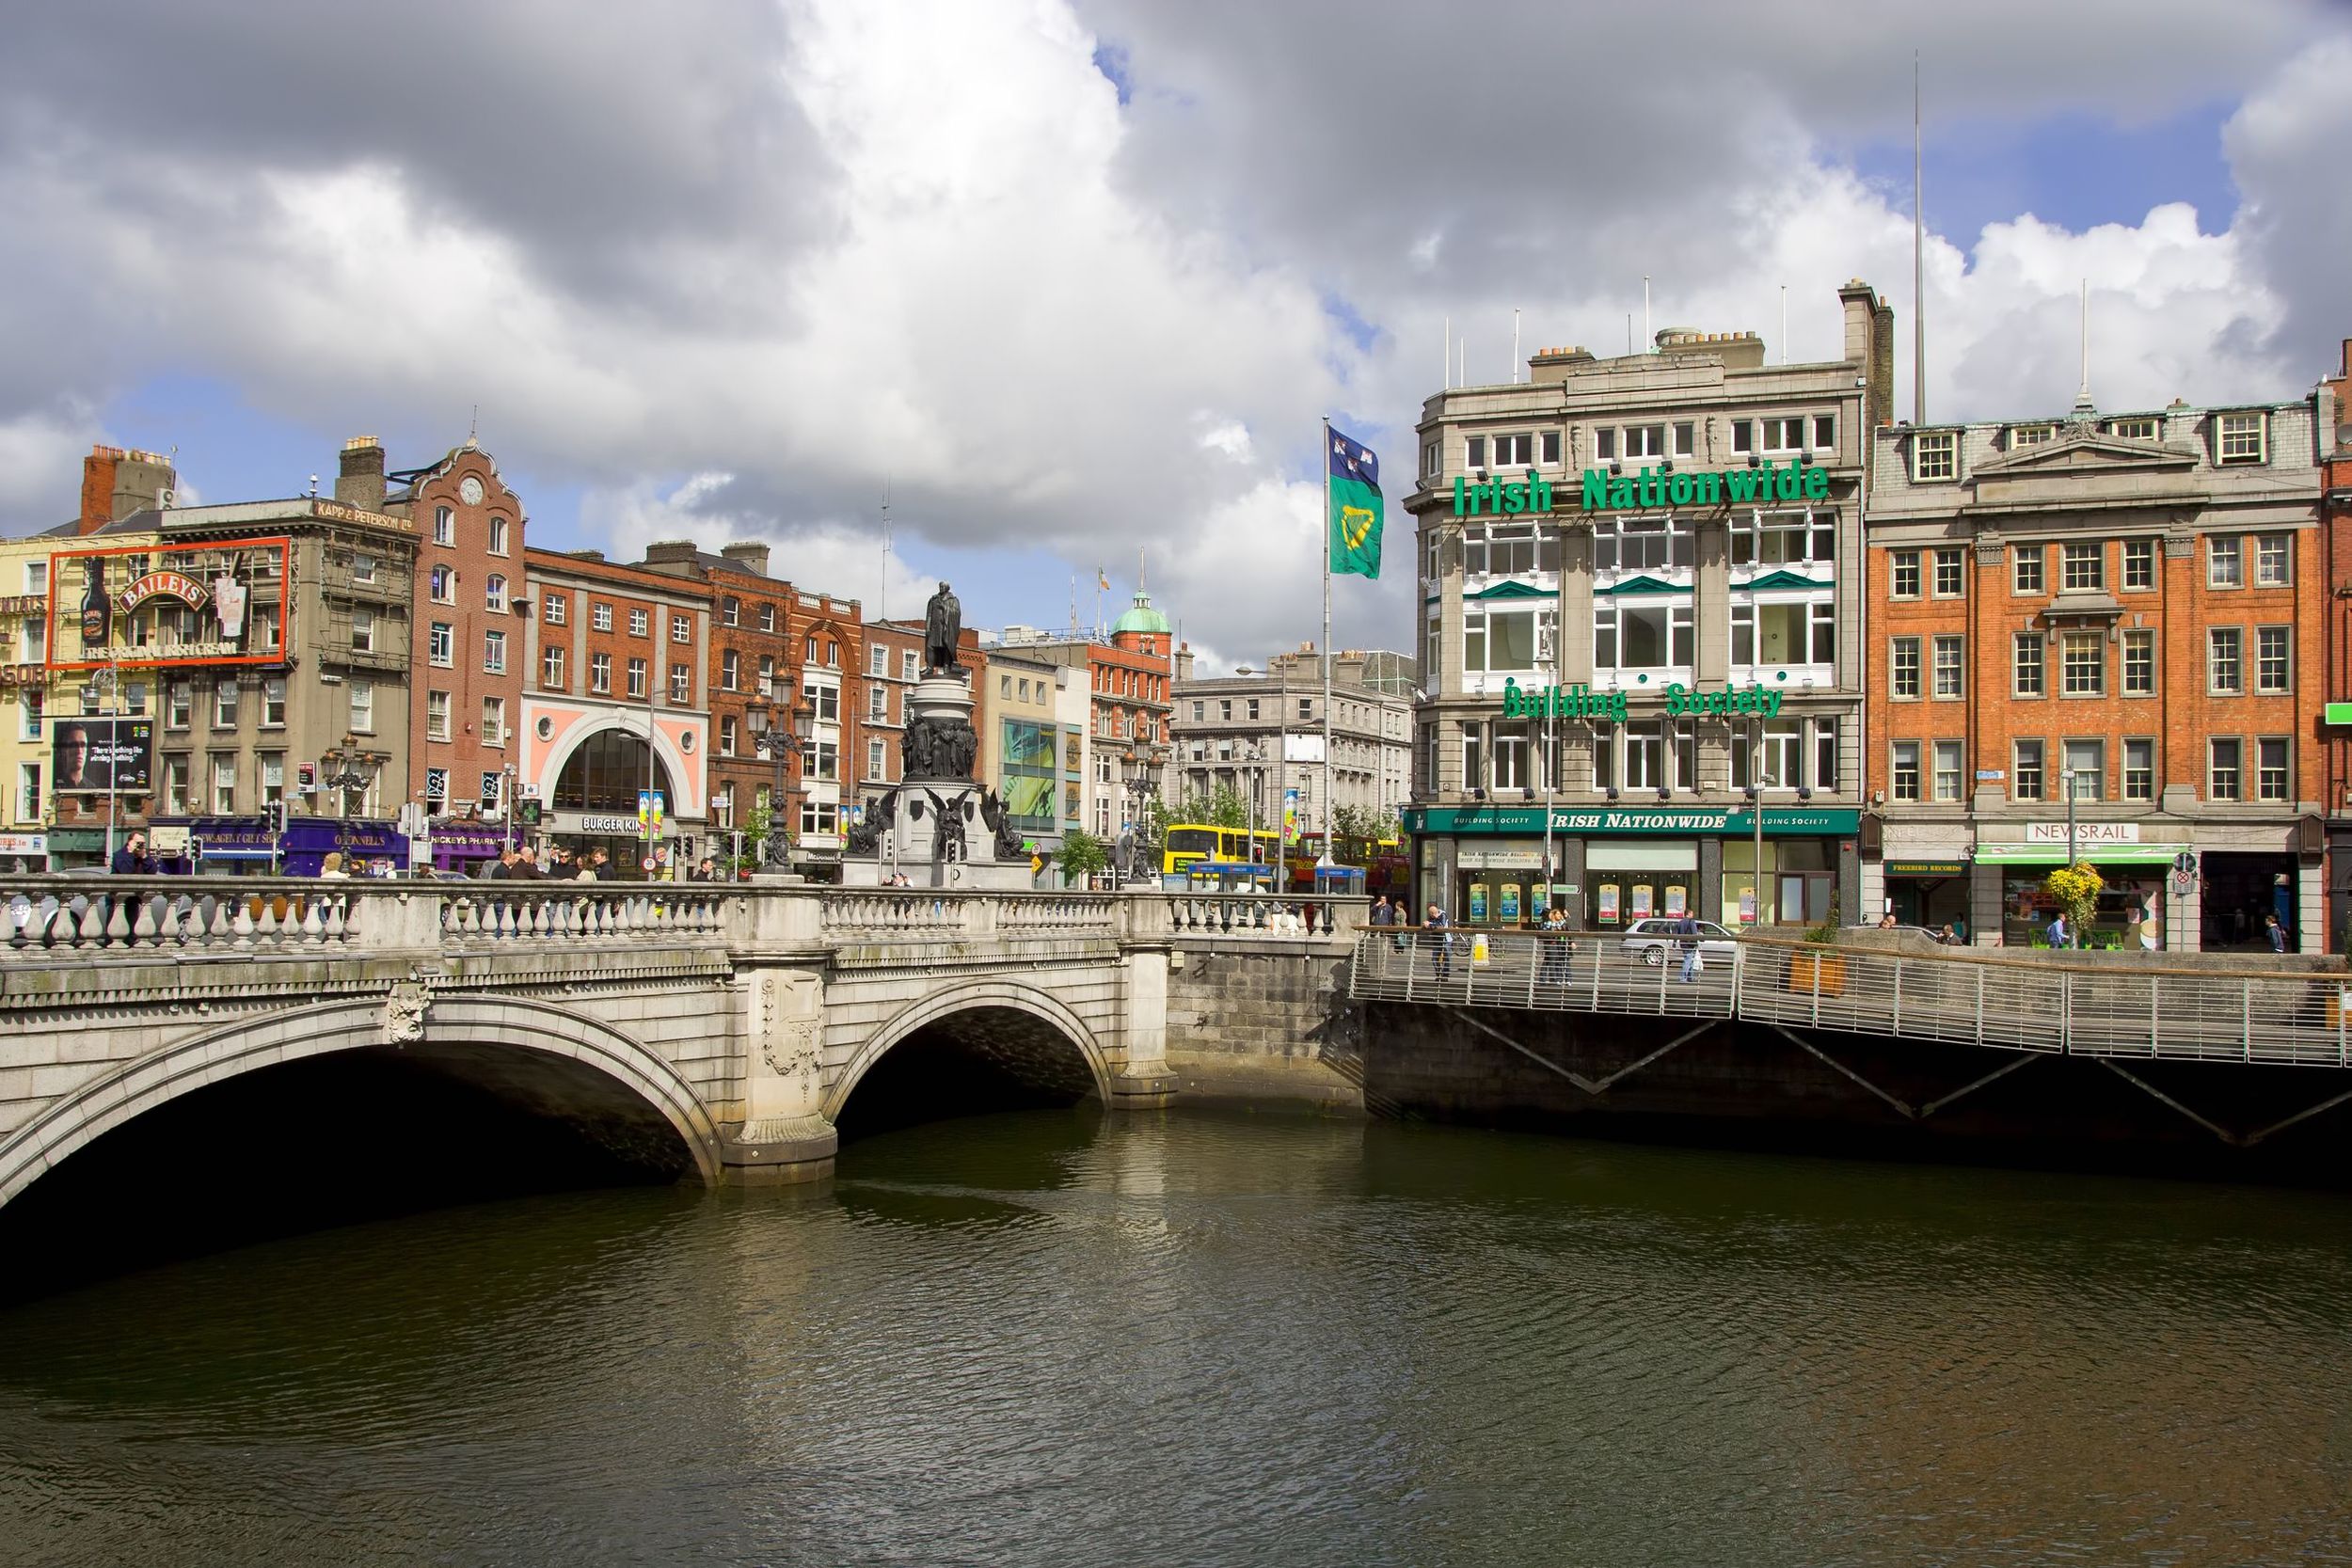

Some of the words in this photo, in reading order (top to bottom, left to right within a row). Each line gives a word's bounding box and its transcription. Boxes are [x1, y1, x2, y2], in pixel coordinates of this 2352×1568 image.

[1454, 470, 1552, 515] Irish
[1582, 458, 1829, 510] Nationwide
[318, 502, 345, 518] KAPP
[355, 509, 399, 530] PETERSON
[123, 575, 200, 607] BAILEYS
[86, 646, 109, 659] THE
[195, 641, 237, 656] CREAM
[0, 664, 45, 686] SOR
[1504, 684, 1628, 722] Building
[1666, 683, 1784, 719] Society
[582, 817, 622, 831] BURGER
[1546, 814, 1601, 828] IRISH
[1604, 813, 1727, 829] NATIONWIDE
[431, 835, 468, 845] HICKEY'S
[2035, 825, 2130, 838] NEWSRAIL
